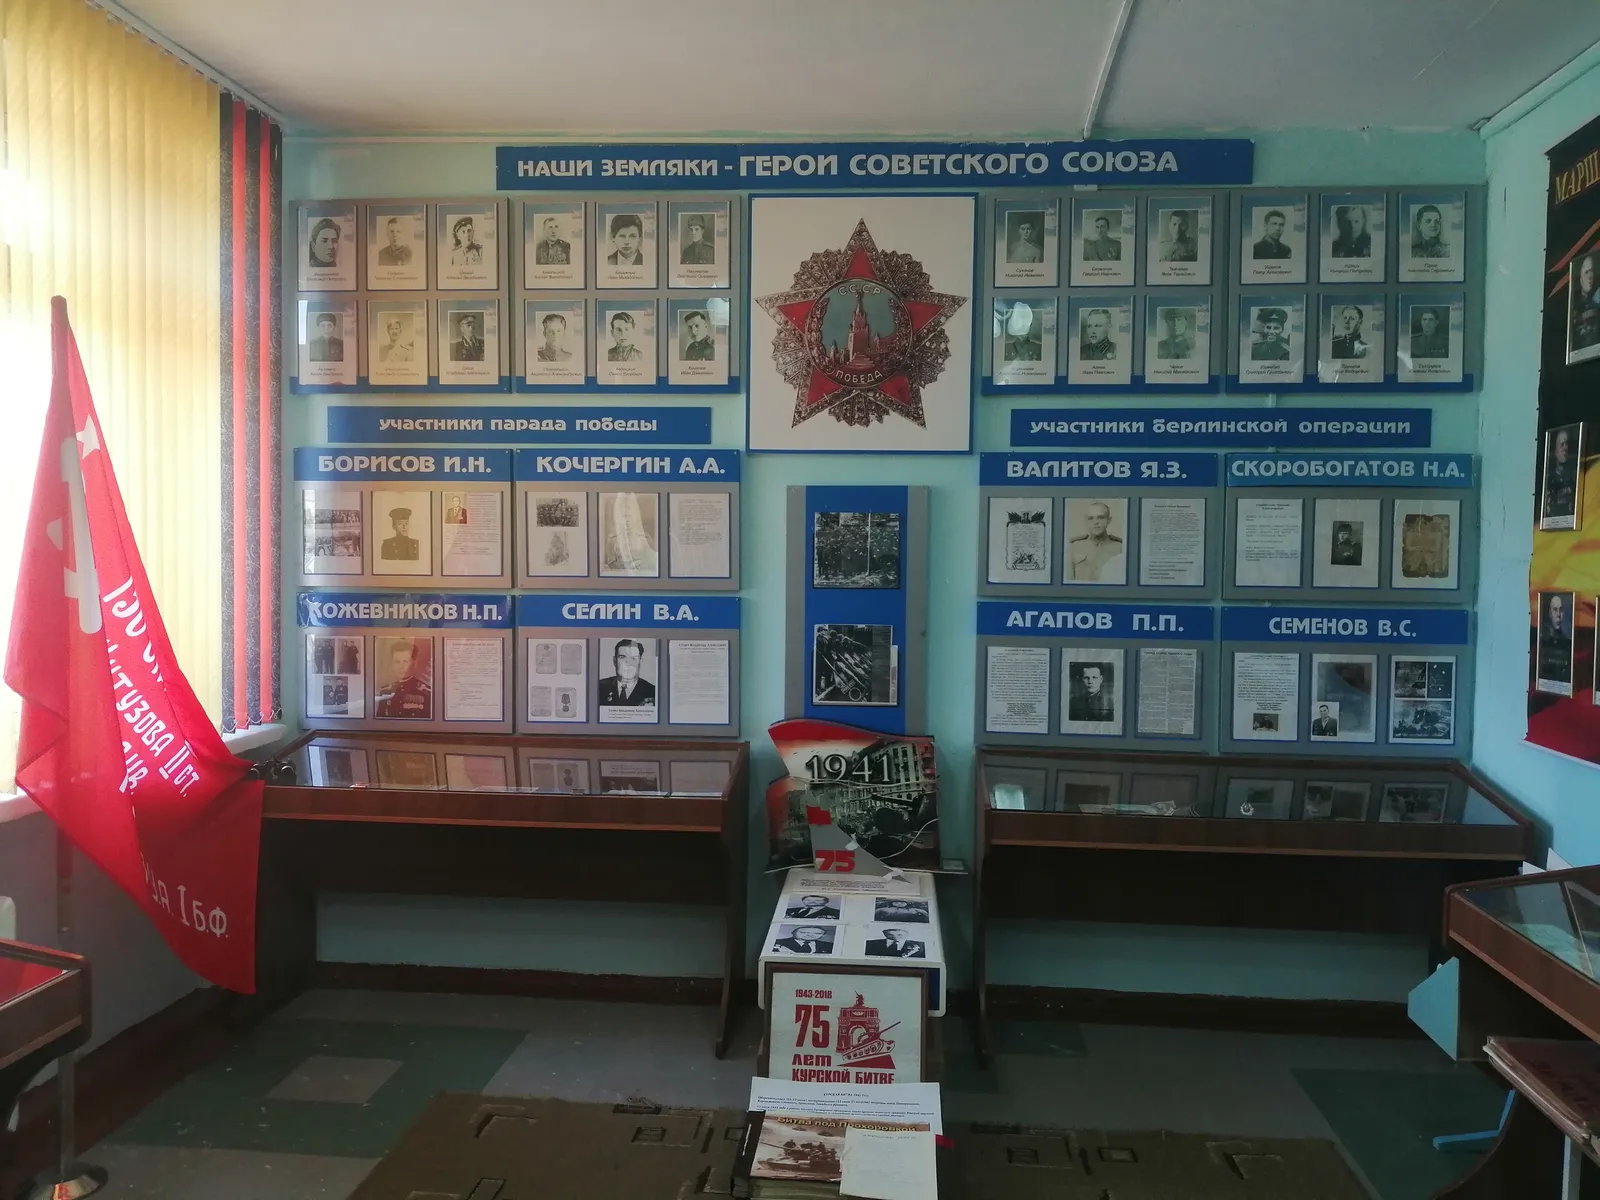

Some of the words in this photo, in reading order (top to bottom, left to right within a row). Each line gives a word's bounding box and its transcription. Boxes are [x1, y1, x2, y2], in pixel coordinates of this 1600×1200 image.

[518, 160, 592, 176] НАШИ
[602, 160, 717, 176] ЗЕМЛЯКИ
[740, 155, 837, 176] ГЕРОИ
[850, 153, 1048, 175] СОВЕТСКОГО
[1062, 151, 1178, 172] СОЮЗА
[838, 284, 881, 296] СССР
[835, 370, 883, 383] ПОБЕДА
[380, 419, 482, 430] участники
[491, 419, 566, 430] парада
[576, 417, 656, 431] победы
[1031, 422, 1144, 433] участники
[1153, 419, 1287, 433] берлинской
[1299, 422, 1410, 433] операции
[319, 456, 435, 472] БОРИСОВ
[444, 457, 491, 472] И.Н.
[537, 457, 670, 473] КОЧЕРГИН
[679, 458, 725, 473] А.А.
[1007, 461, 1130, 477] ВАЛИТОВ
[1141, 462, 1186, 478] Я.З.
[1232, 461, 1414, 476] СКОРОБОГАТОВ
[1424, 462, 1464, 477] Н.А.
[311, 603, 458, 621] КОЖЕВНИКОВ
[463, 604, 502, 620] Н.П.
[562, 603, 640, 619] СЕЛИН
[654, 604, 699, 620] В.А.
[1007, 611, 1112, 629] АГАПОВ
[1133, 614, 1183, 631] П.П.
[1269, 617, 1367, 635] СЕМЕНОВ
[1378, 620, 1416, 637] В.С.
[805, 752, 893, 785] 1941
[815, 849, 856, 872] 75
[795, 989, 832, 999] 1943-2018
[794, 1004, 830, 1049] 75
[792, 1068, 851, 1084] КУРСКОЙ
[777, 1116, 812, 1126] Битва
